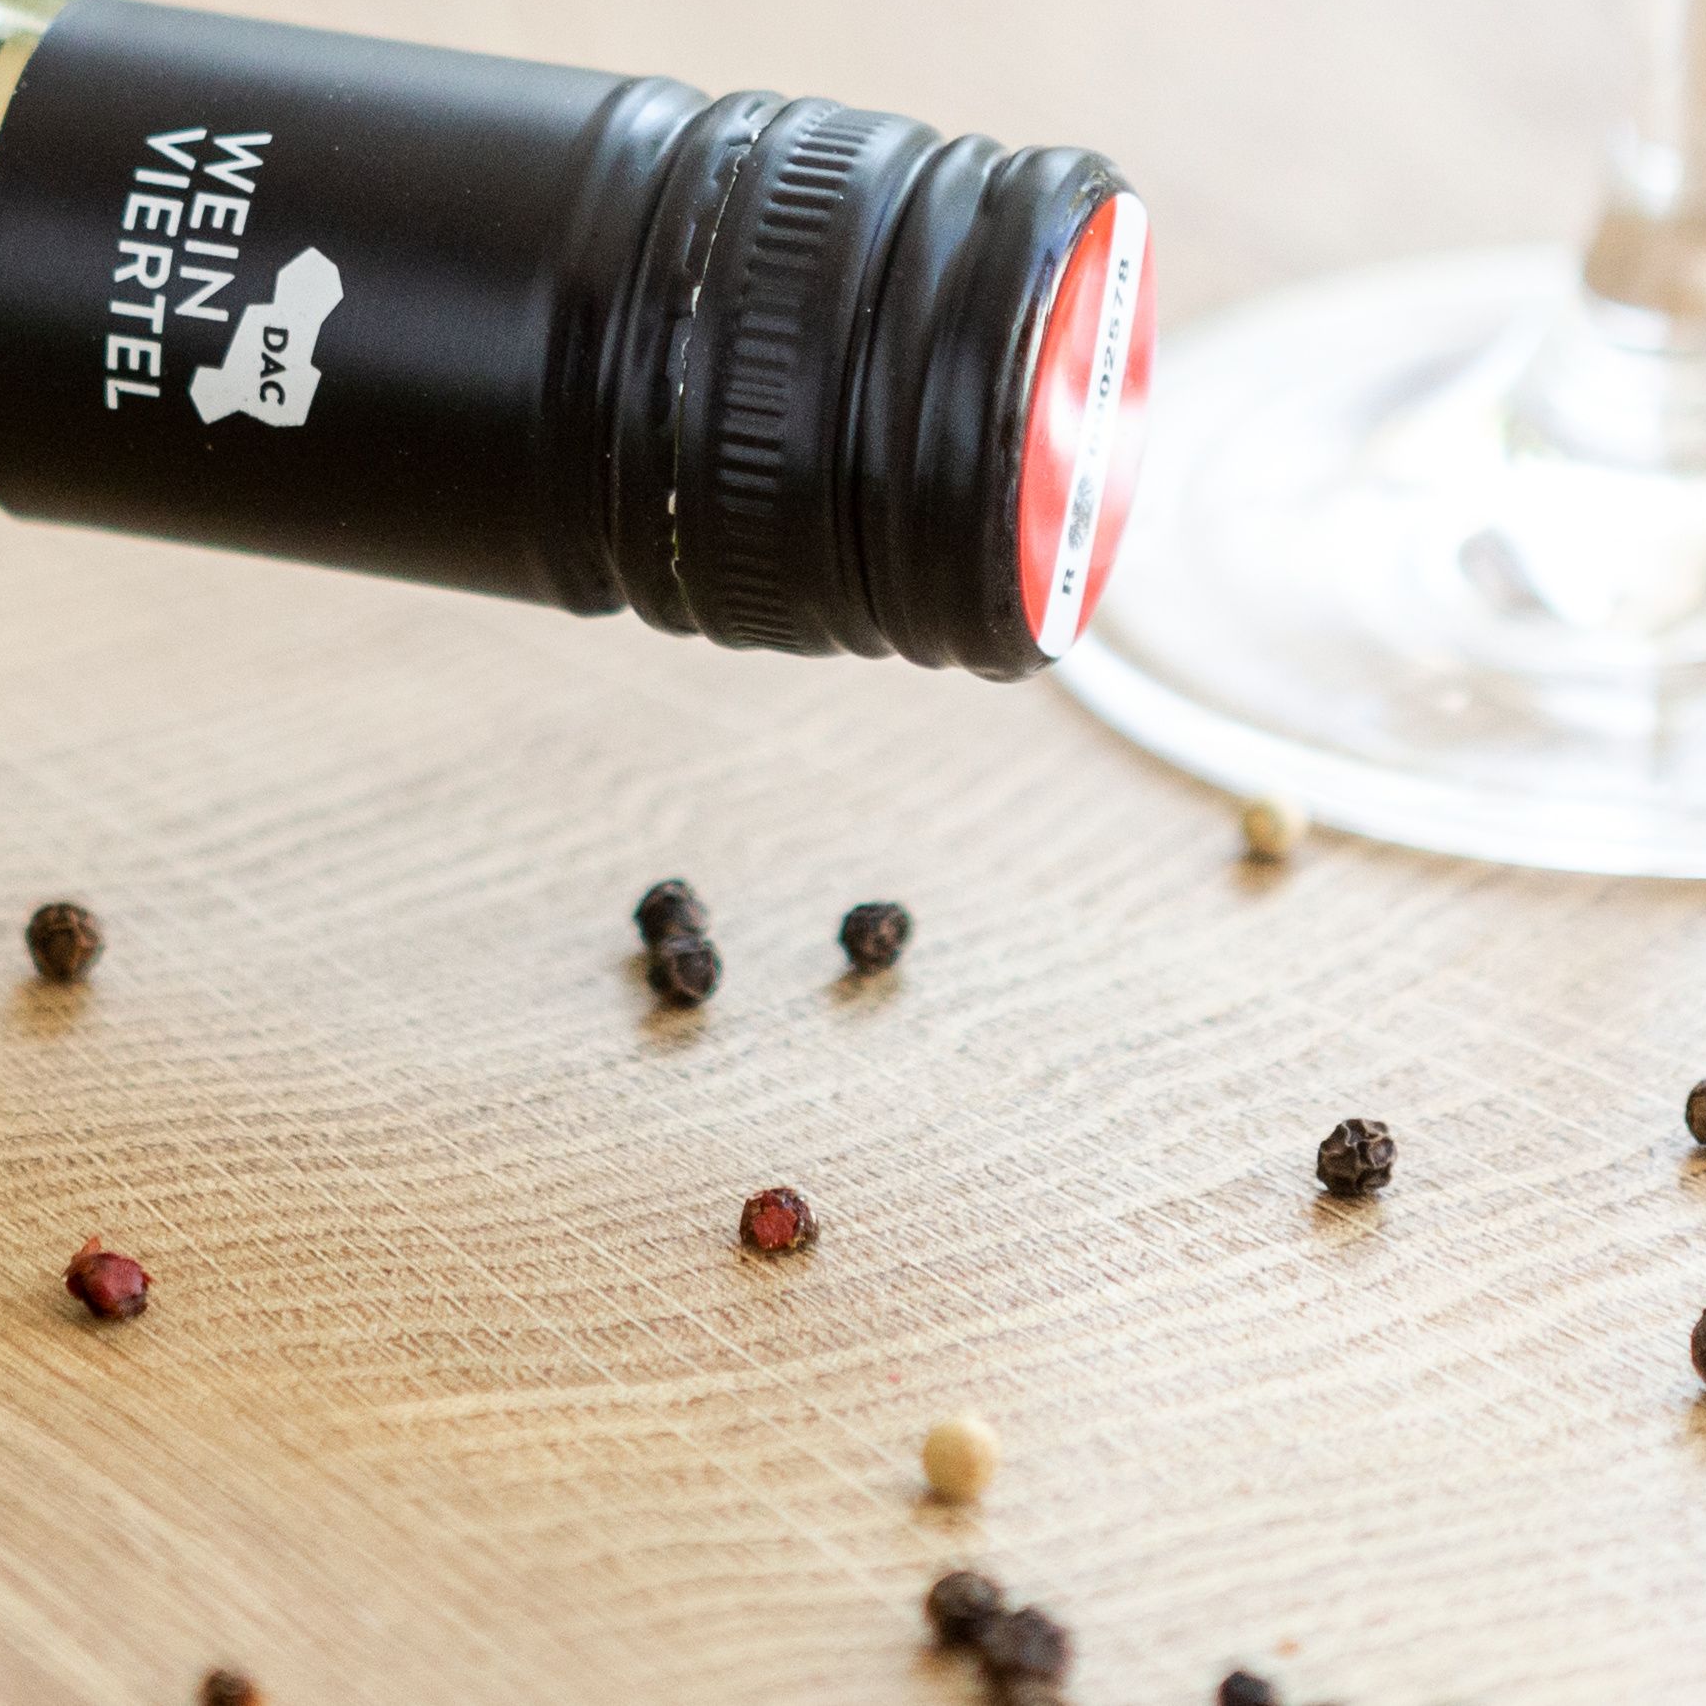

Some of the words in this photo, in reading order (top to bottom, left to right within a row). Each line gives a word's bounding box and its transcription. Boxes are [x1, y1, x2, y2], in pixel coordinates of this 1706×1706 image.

[104, 126, 208, 411] VIERTEL
[174, 131, 273, 322] WEIN
[258, 325, 290, 407] DAC
